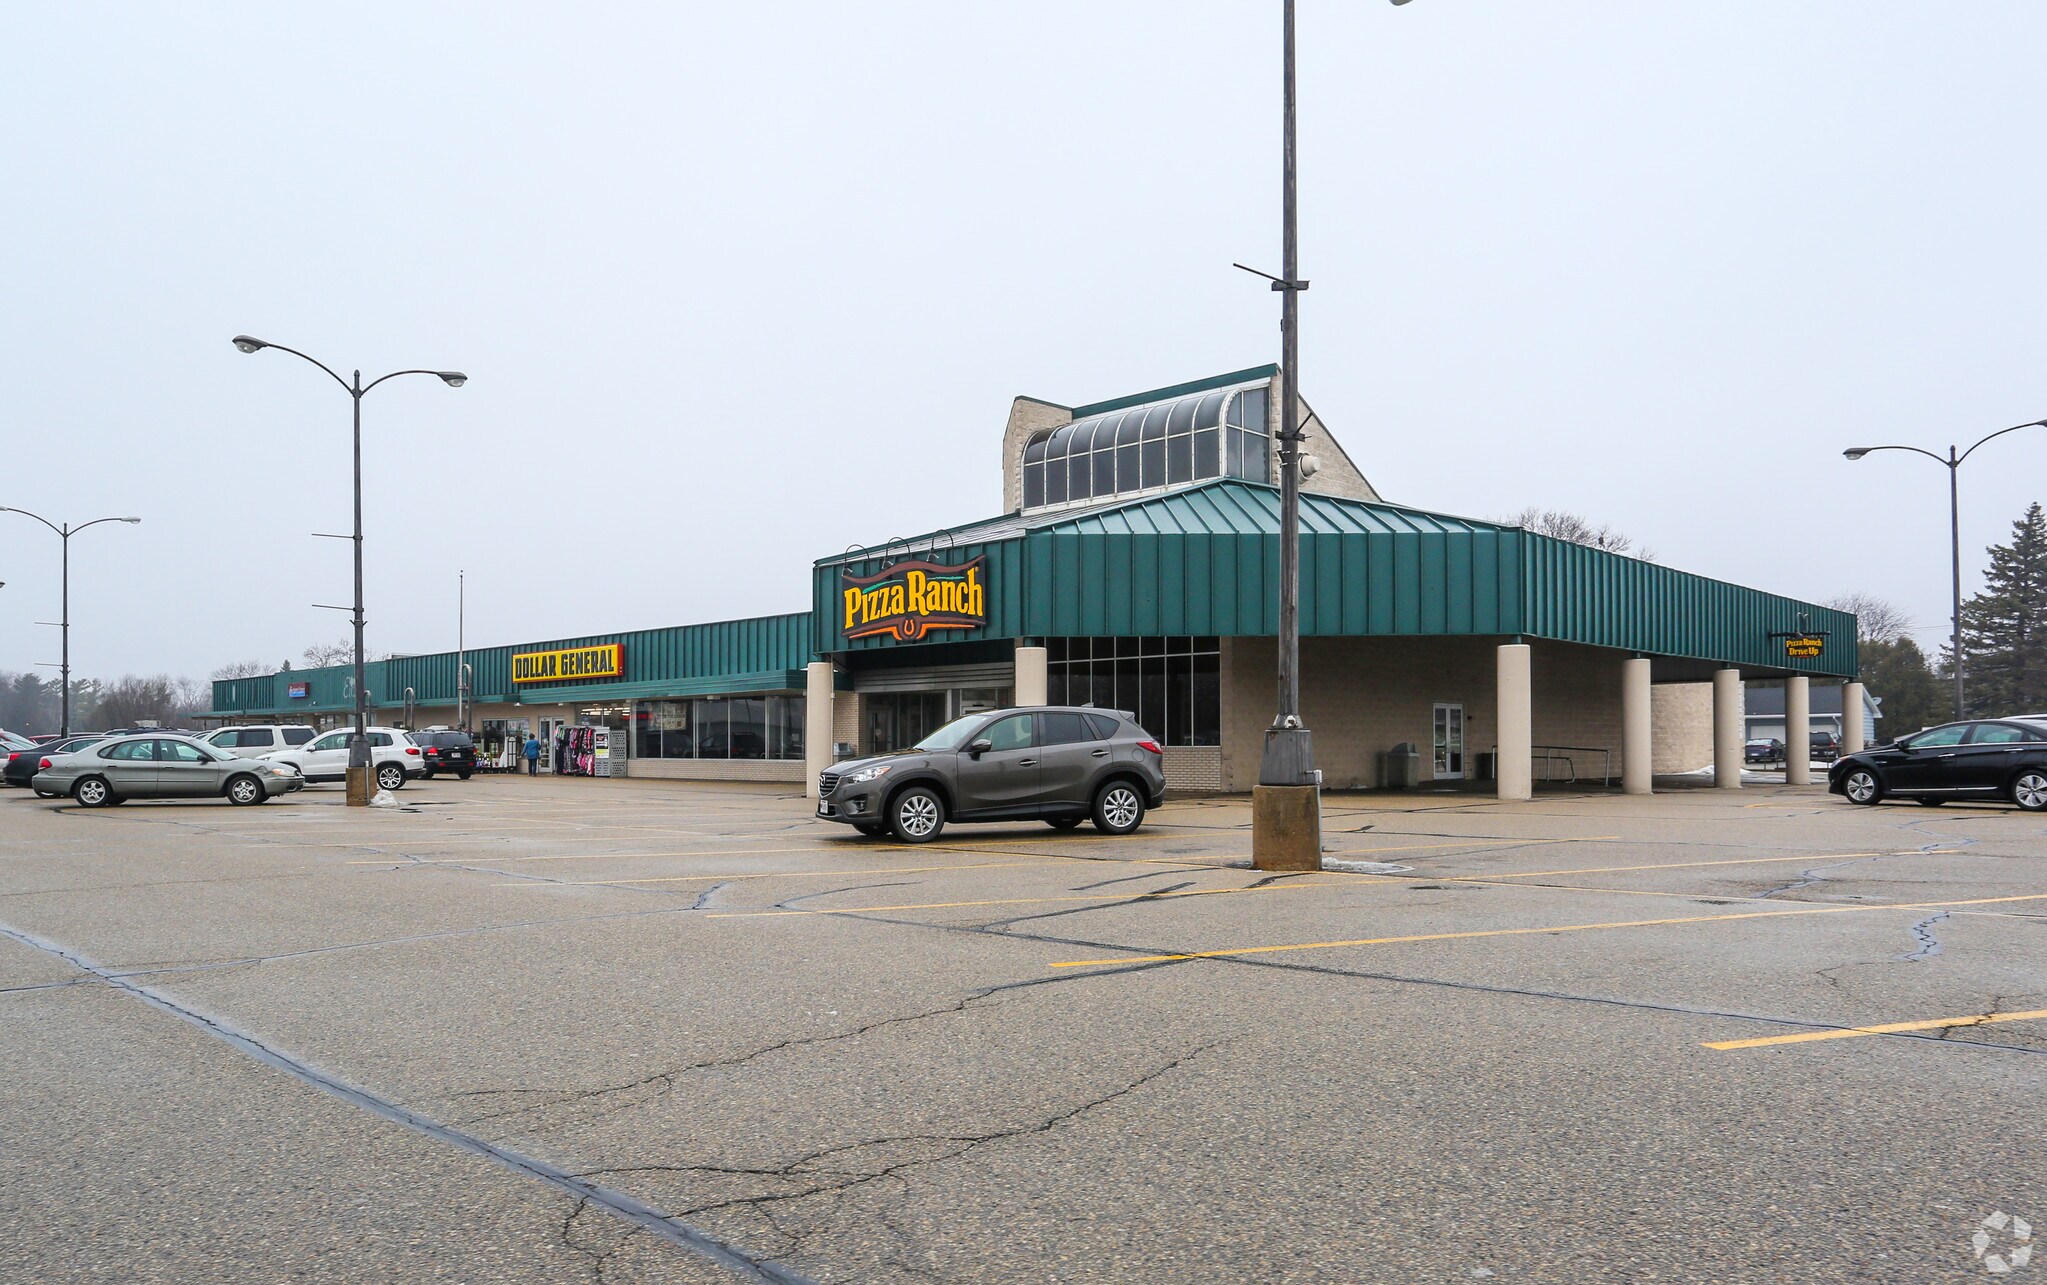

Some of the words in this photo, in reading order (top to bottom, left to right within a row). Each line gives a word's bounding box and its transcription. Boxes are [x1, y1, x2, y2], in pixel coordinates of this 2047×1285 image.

[844, 584, 904, 629] Pizza
[907, 567, 983, 616] Ranch
[1803, 638, 1822, 646] Ranch
[1808, 647, 1819, 656] Up
[515, 655, 557, 678] DOLLAR
[560, 649, 614, 675] GENERAL
